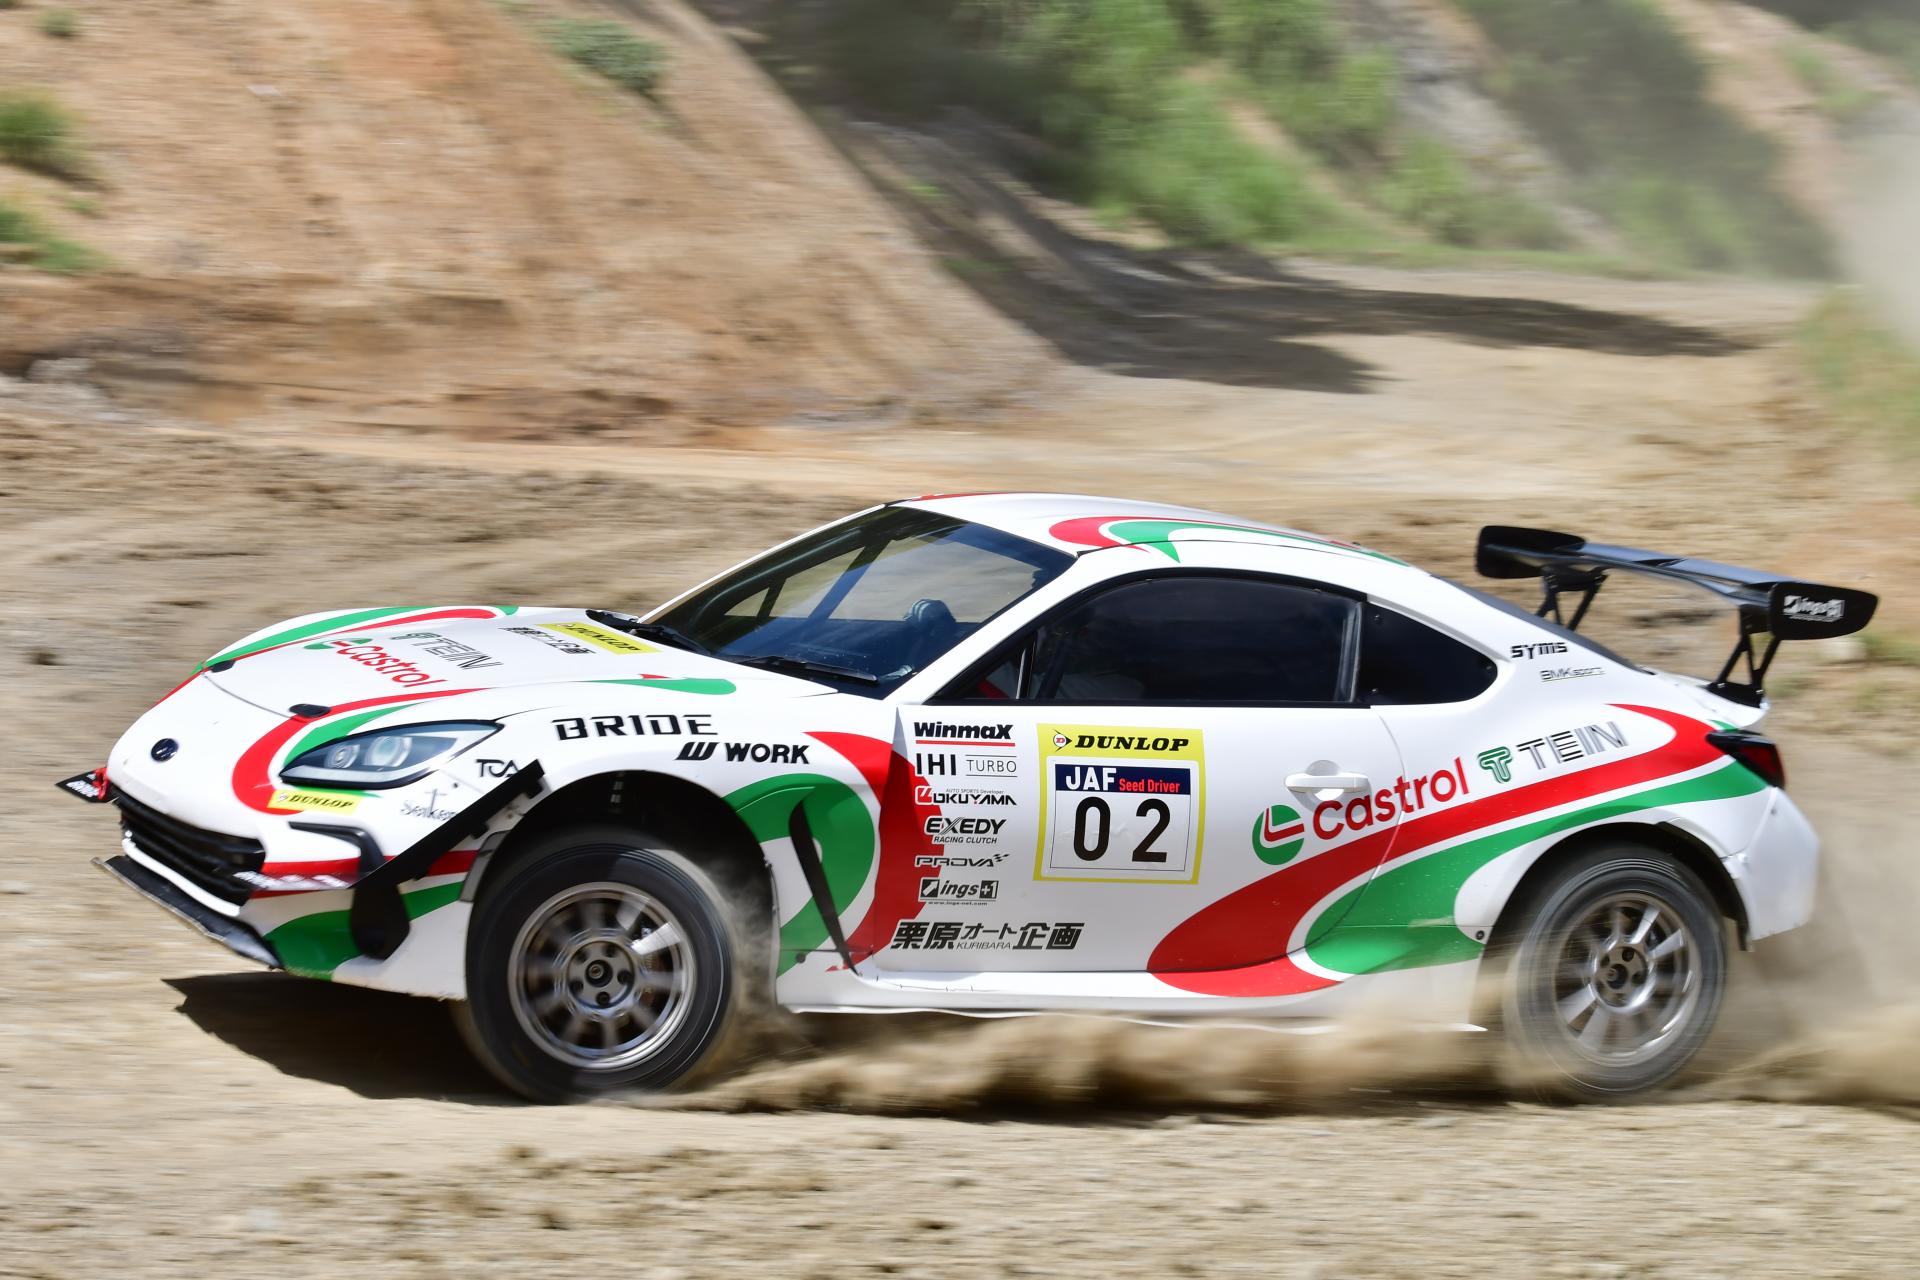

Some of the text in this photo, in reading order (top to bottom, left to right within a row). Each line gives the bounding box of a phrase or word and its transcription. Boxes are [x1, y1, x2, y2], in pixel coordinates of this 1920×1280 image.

[411, 638, 503, 670] TEIN
[336, 645, 447, 688] Castrol
[551, 714, 718, 741] BRIDE
[724, 742, 810, 765] WORK
[1075, 735, 1189, 752] DUNLOP
[1516, 721, 1629, 770] TEIN
[916, 753, 1017, 776] IHI TURBO
[1065, 766, 1180, 794] JAF Seed Driver
[289, 794, 354, 808] DUNLOP
[933, 793, 1018, 806] OKUYAMA
[1312, 757, 1471, 841] Castrol
[926, 817, 1007, 835] EXEDY
[934, 836, 998, 845] RACING CLUTCH
[916, 857, 995, 867] PROVA
[956, 941, 1011, 950] KURIBARA
